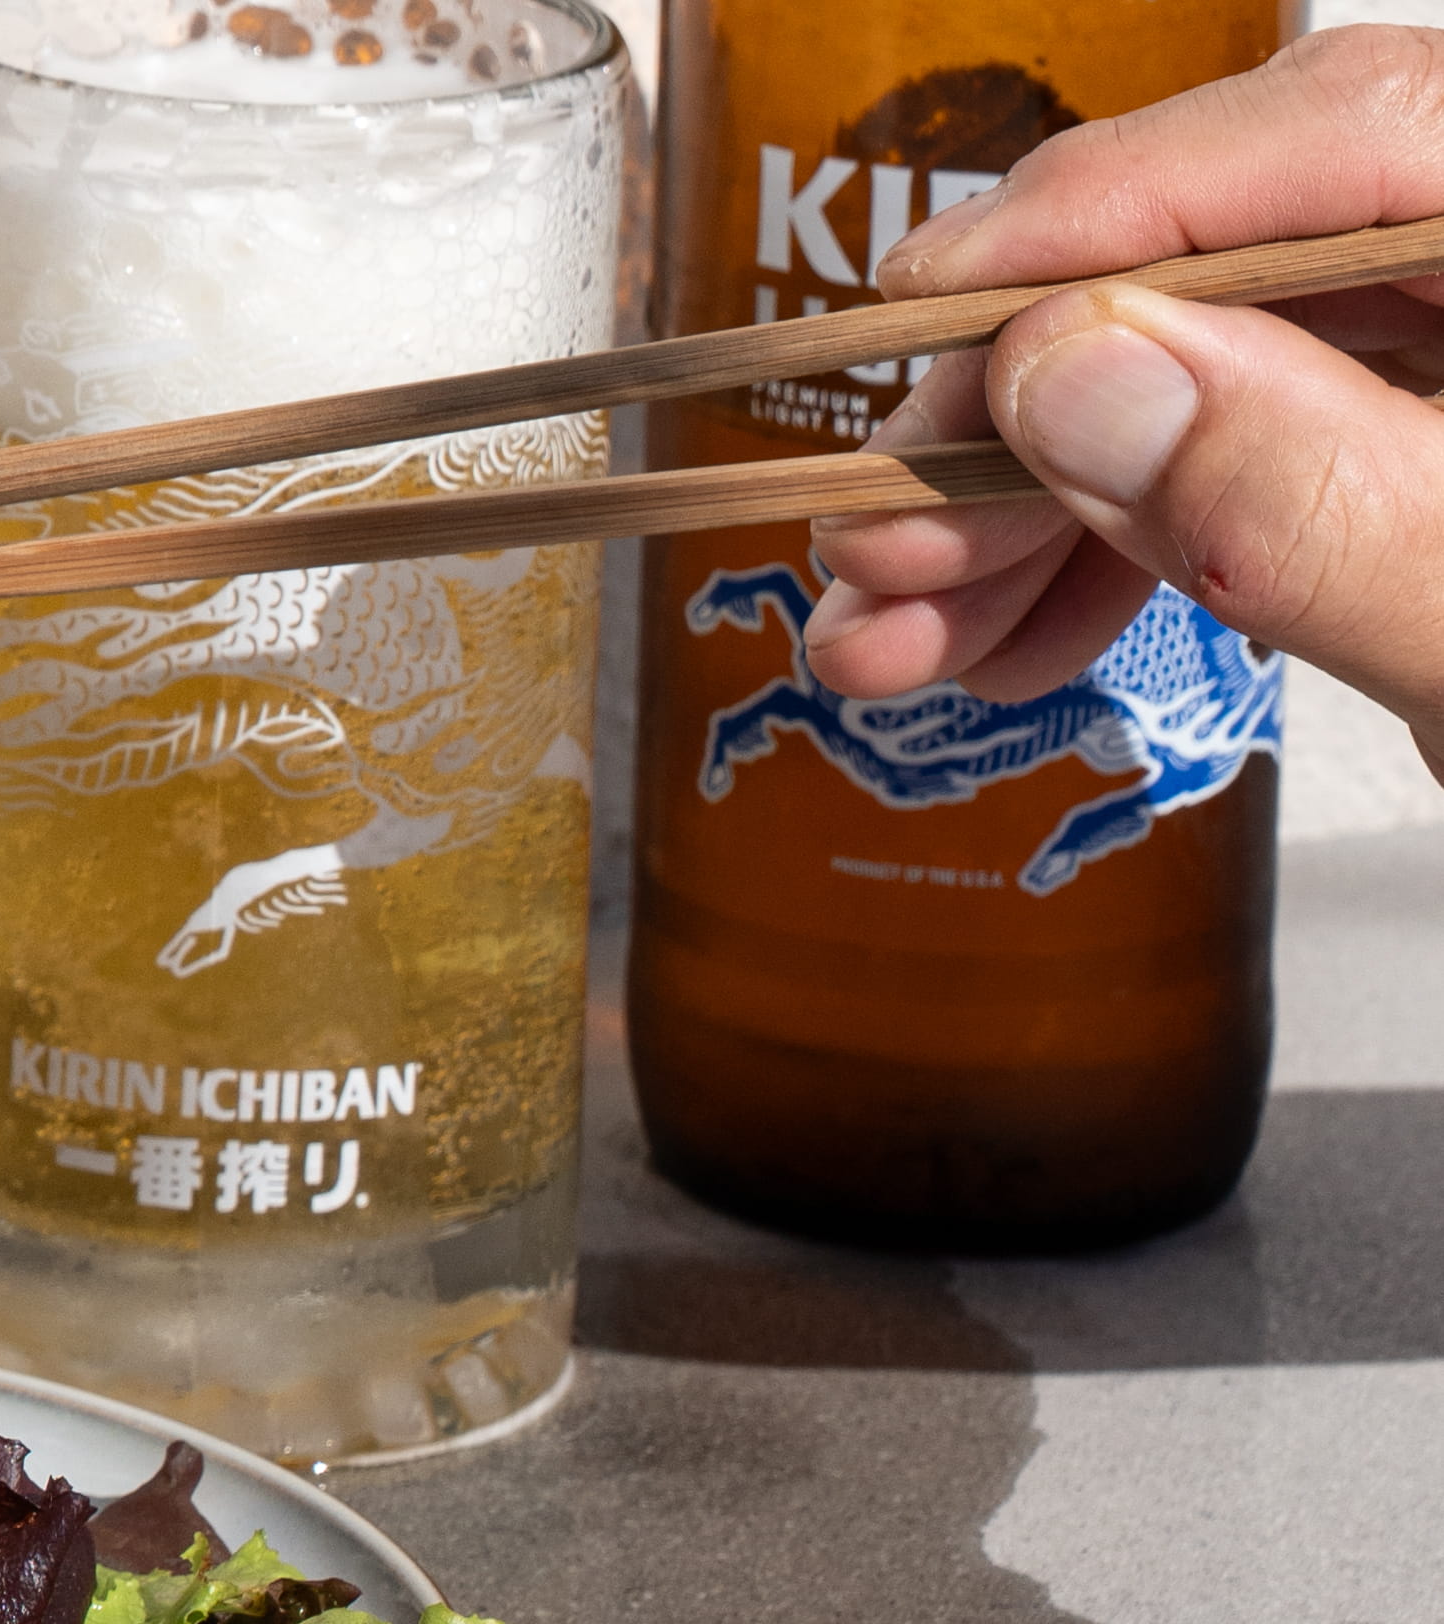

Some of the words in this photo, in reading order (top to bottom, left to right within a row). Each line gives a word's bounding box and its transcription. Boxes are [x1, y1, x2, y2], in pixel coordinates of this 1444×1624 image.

[751, 398, 823, 432] LIGHT
[11, 1038, 166, 1115] KIRIN
[180, 1062, 416, 1122] ICHIBAN
